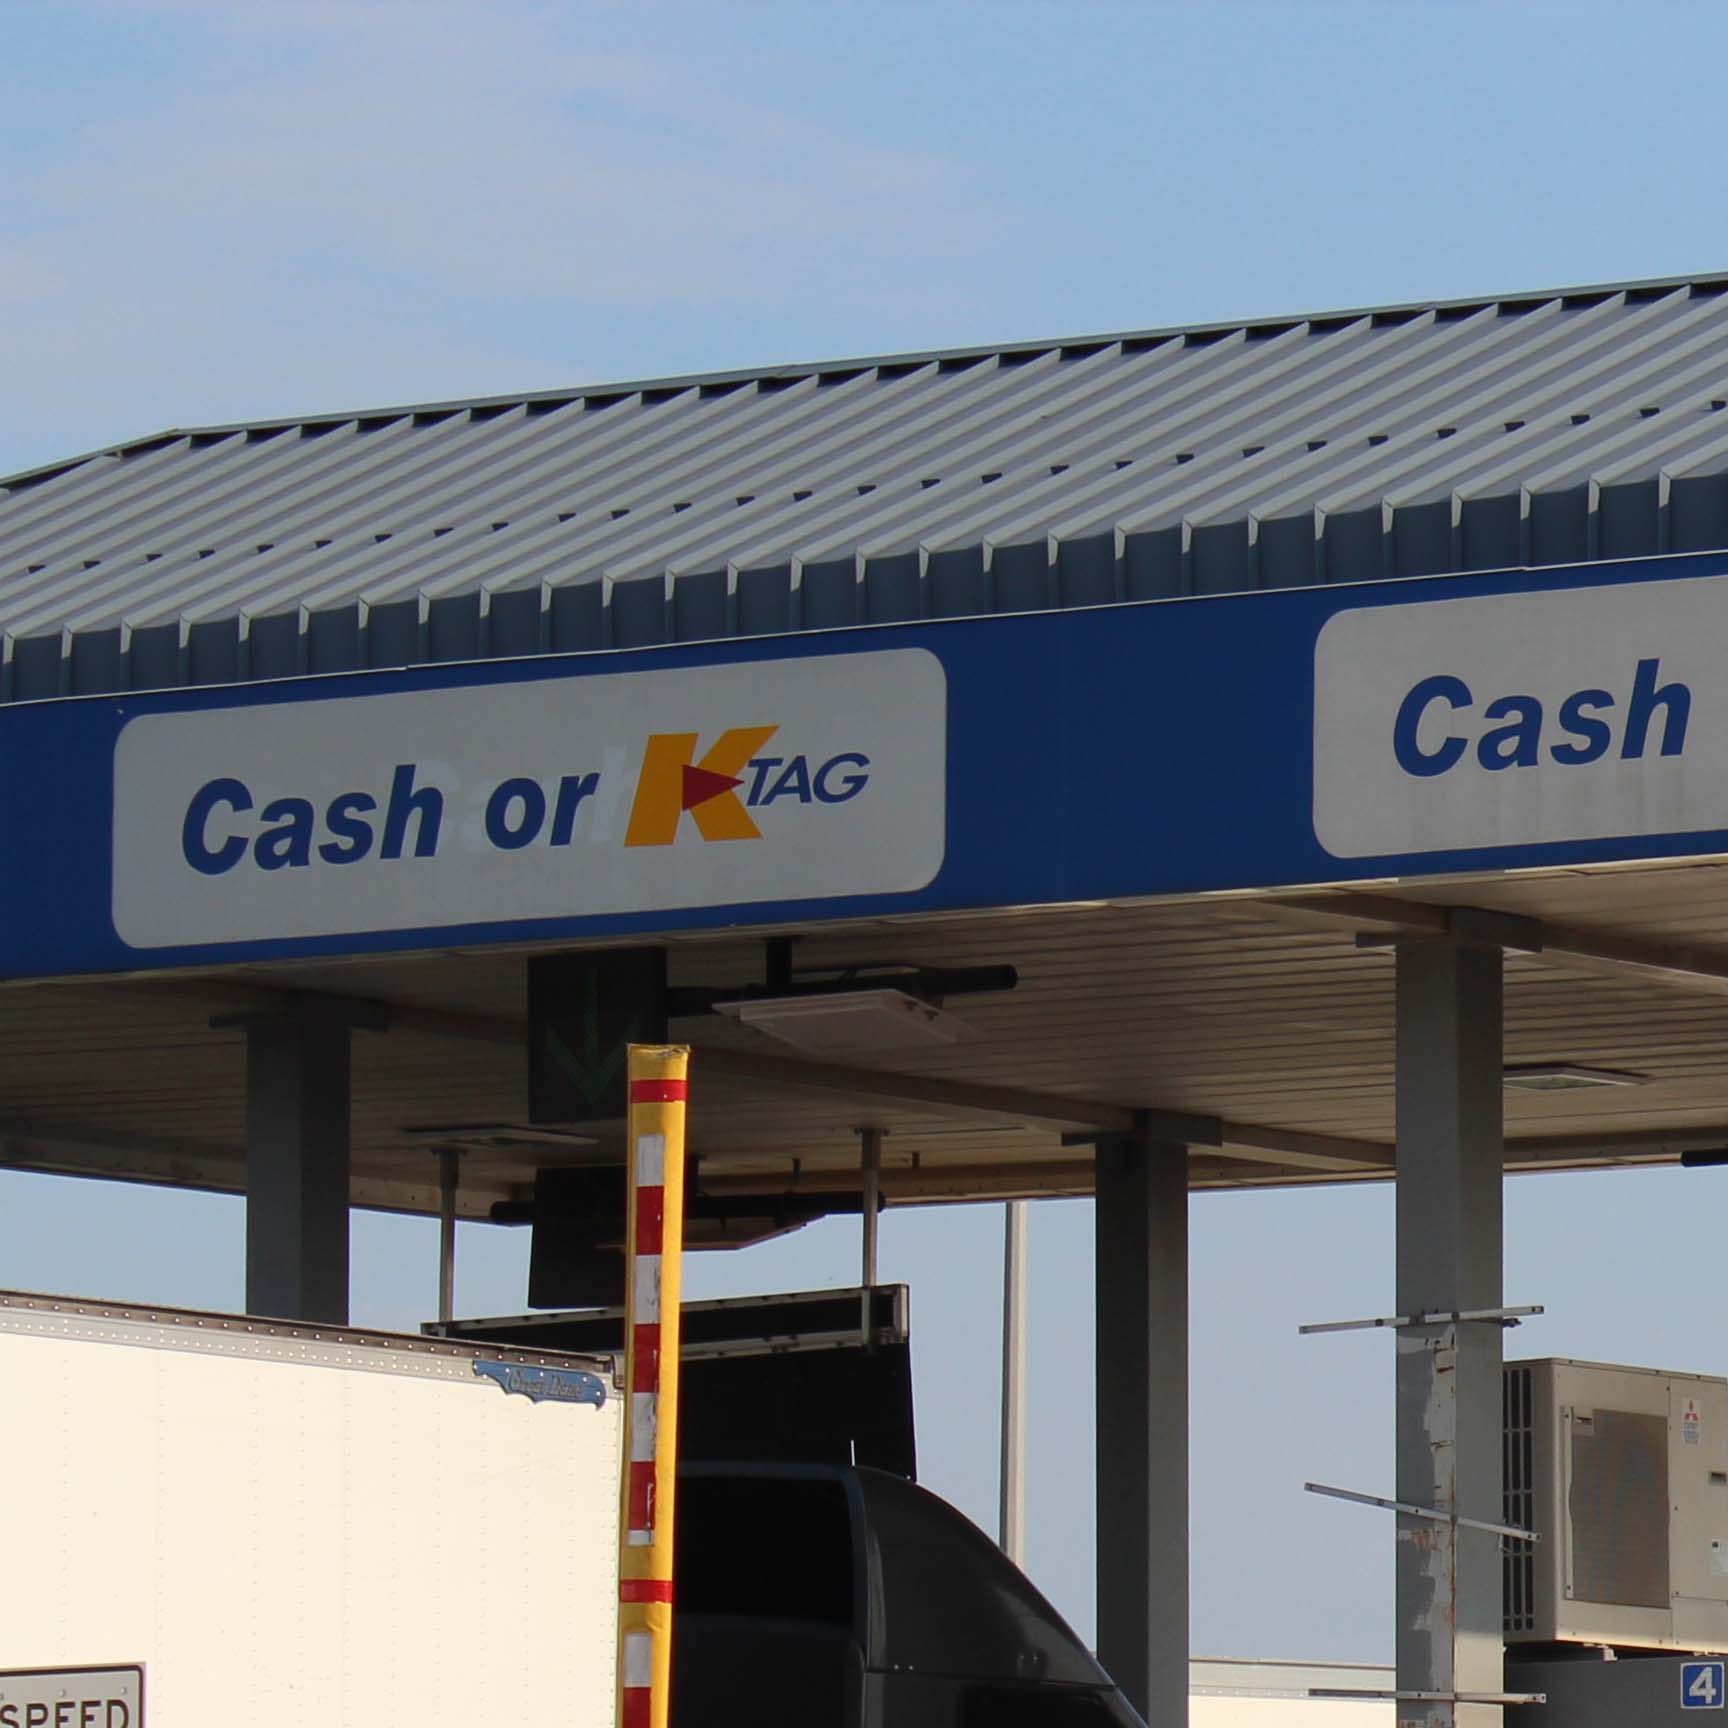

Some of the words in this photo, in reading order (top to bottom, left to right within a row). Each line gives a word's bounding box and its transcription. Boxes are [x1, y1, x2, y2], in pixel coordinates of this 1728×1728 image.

[1393, 657, 1692, 777] Cash
[181, 764, 444, 876] Cash
[485, 772, 601, 851] or
[1688, 1666, 1717, 1705] 4
